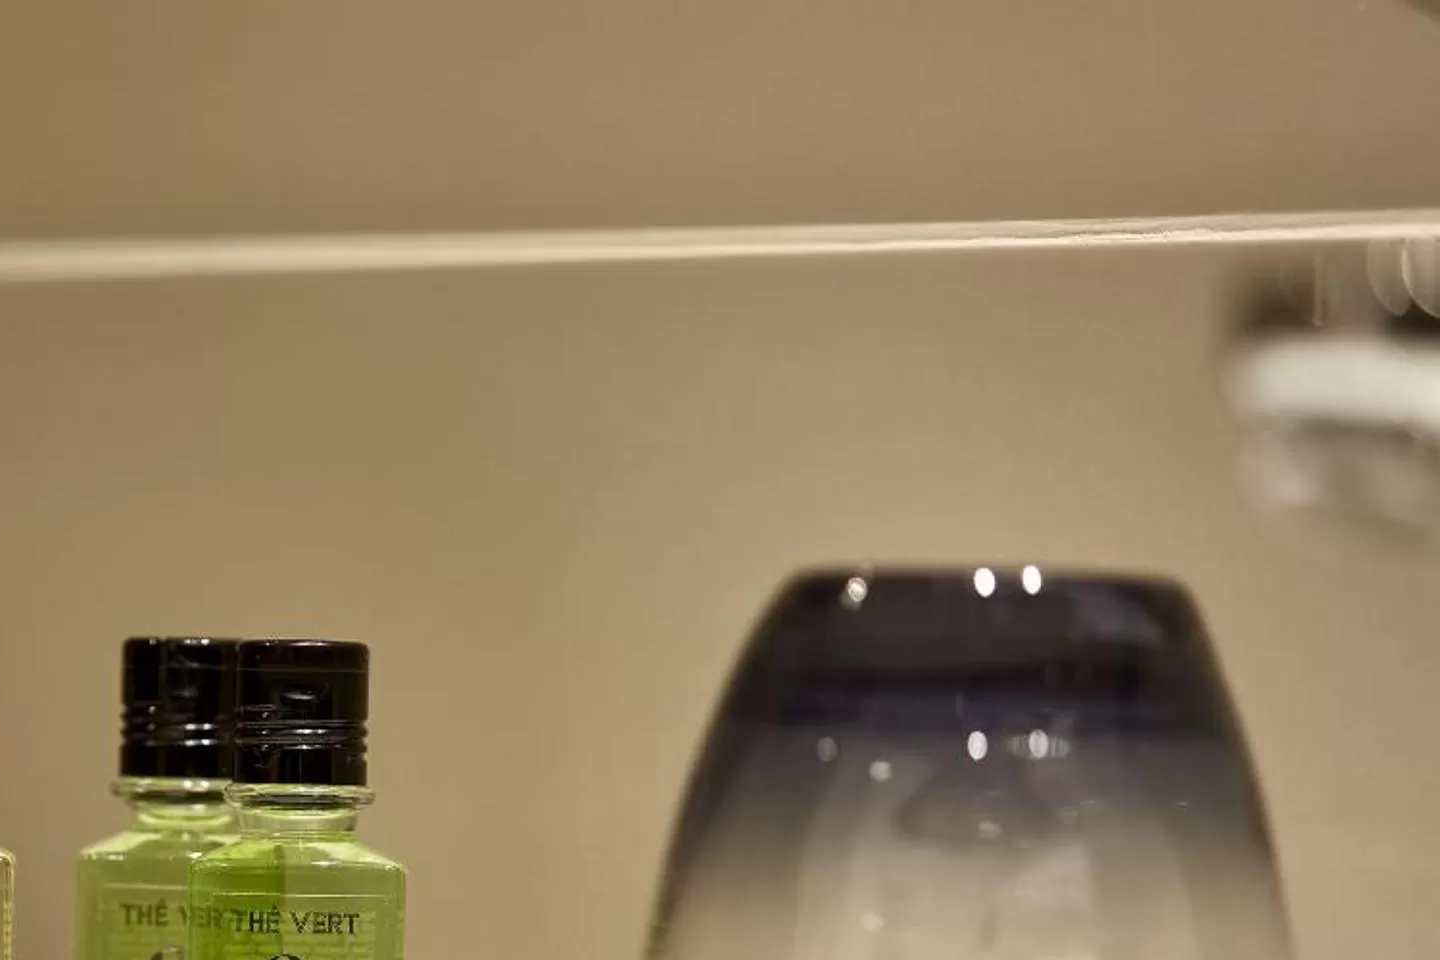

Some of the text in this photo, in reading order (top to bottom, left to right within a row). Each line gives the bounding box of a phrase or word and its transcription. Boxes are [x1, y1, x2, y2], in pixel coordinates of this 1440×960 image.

[120, 899, 168, 926] THÉ
[230, 905, 360, 935] THÉ VERT
